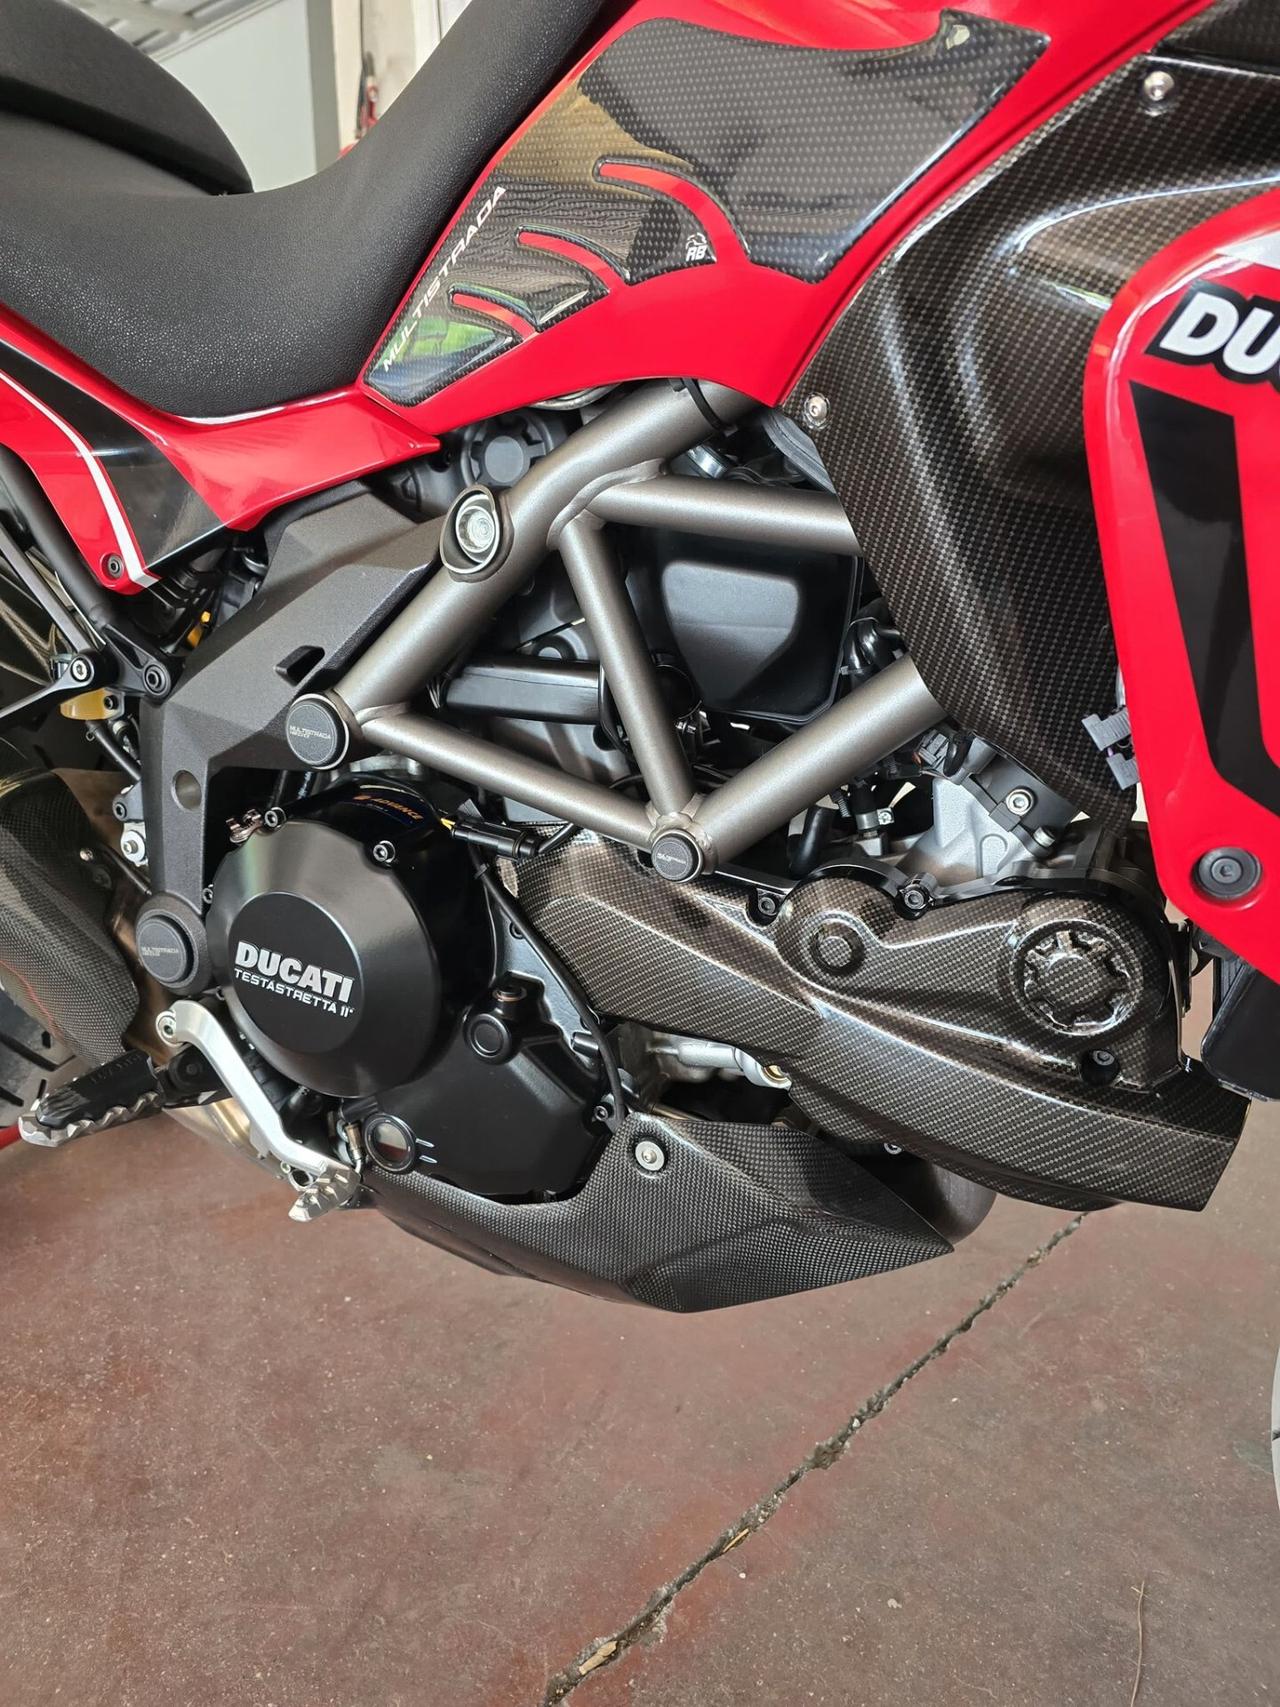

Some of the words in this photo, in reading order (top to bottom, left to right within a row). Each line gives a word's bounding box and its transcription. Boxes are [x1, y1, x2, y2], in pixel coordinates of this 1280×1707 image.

[382, 186, 506, 373] MULTISTRADA
[233, 968, 337, 1014] TESTASTRETTA
[235, 941, 354, 1003] DUCATI
